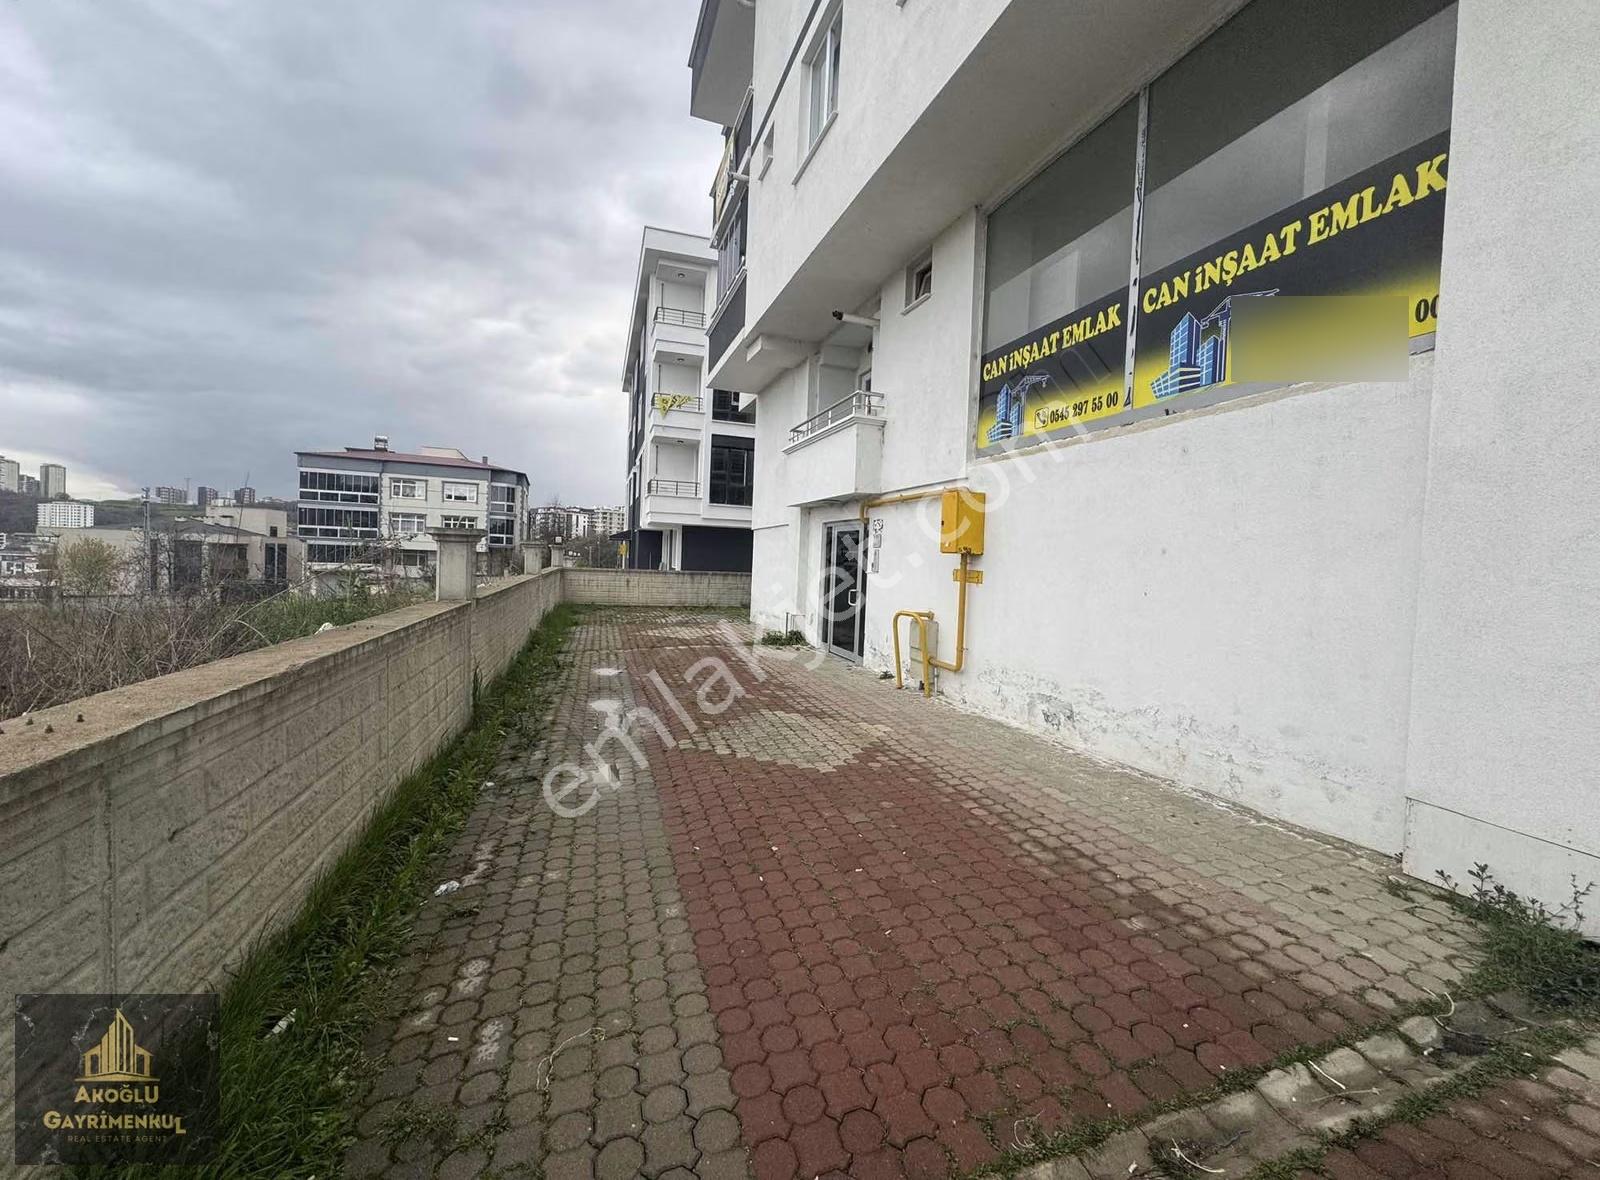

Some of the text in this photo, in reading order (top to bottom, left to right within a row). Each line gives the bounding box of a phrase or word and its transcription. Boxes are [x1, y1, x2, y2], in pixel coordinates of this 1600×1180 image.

[1142, 271, 1190, 314] CAN
[1306, 153, 1447, 246] EMLAK
[983, 354, 1007, 382] CAN
[1062, 303, 1121, 349] EMLAK
[1050, 391, 1119, 424] 0545 297 55 00
